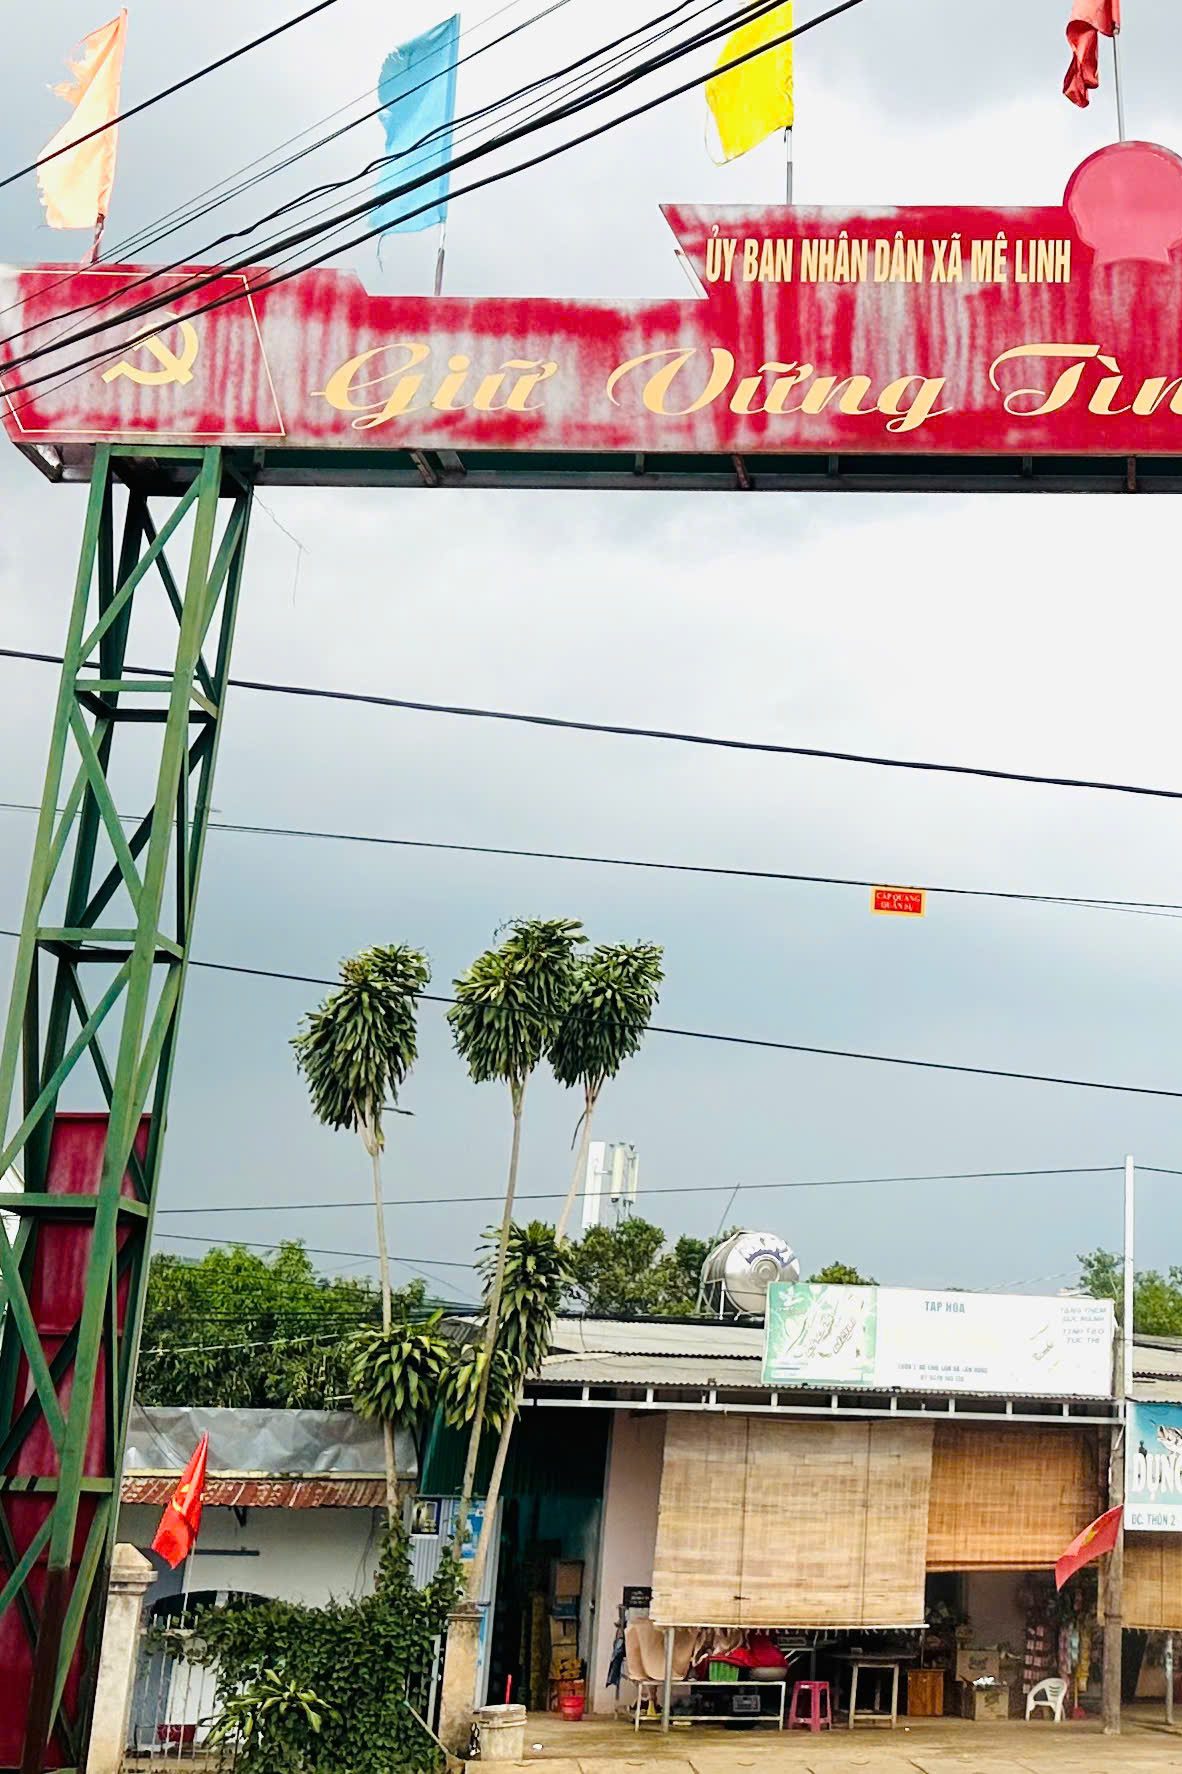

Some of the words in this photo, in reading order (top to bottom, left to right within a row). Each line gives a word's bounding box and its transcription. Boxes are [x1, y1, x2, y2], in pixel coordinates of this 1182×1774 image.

[706, 225, 736, 283] ỦY
[743, 238, 794, 283] BAN
[801, 231, 869, 283] NHÂN
[873, 231, 924, 283] DÂN
[930, 232, 963, 283] XÃ
[970, 231, 1008, 283] MÊ
[1014, 239, 1071, 283] LINH
[310, 342, 560, 430] Giữ
[607, 346, 954, 433] Vững
